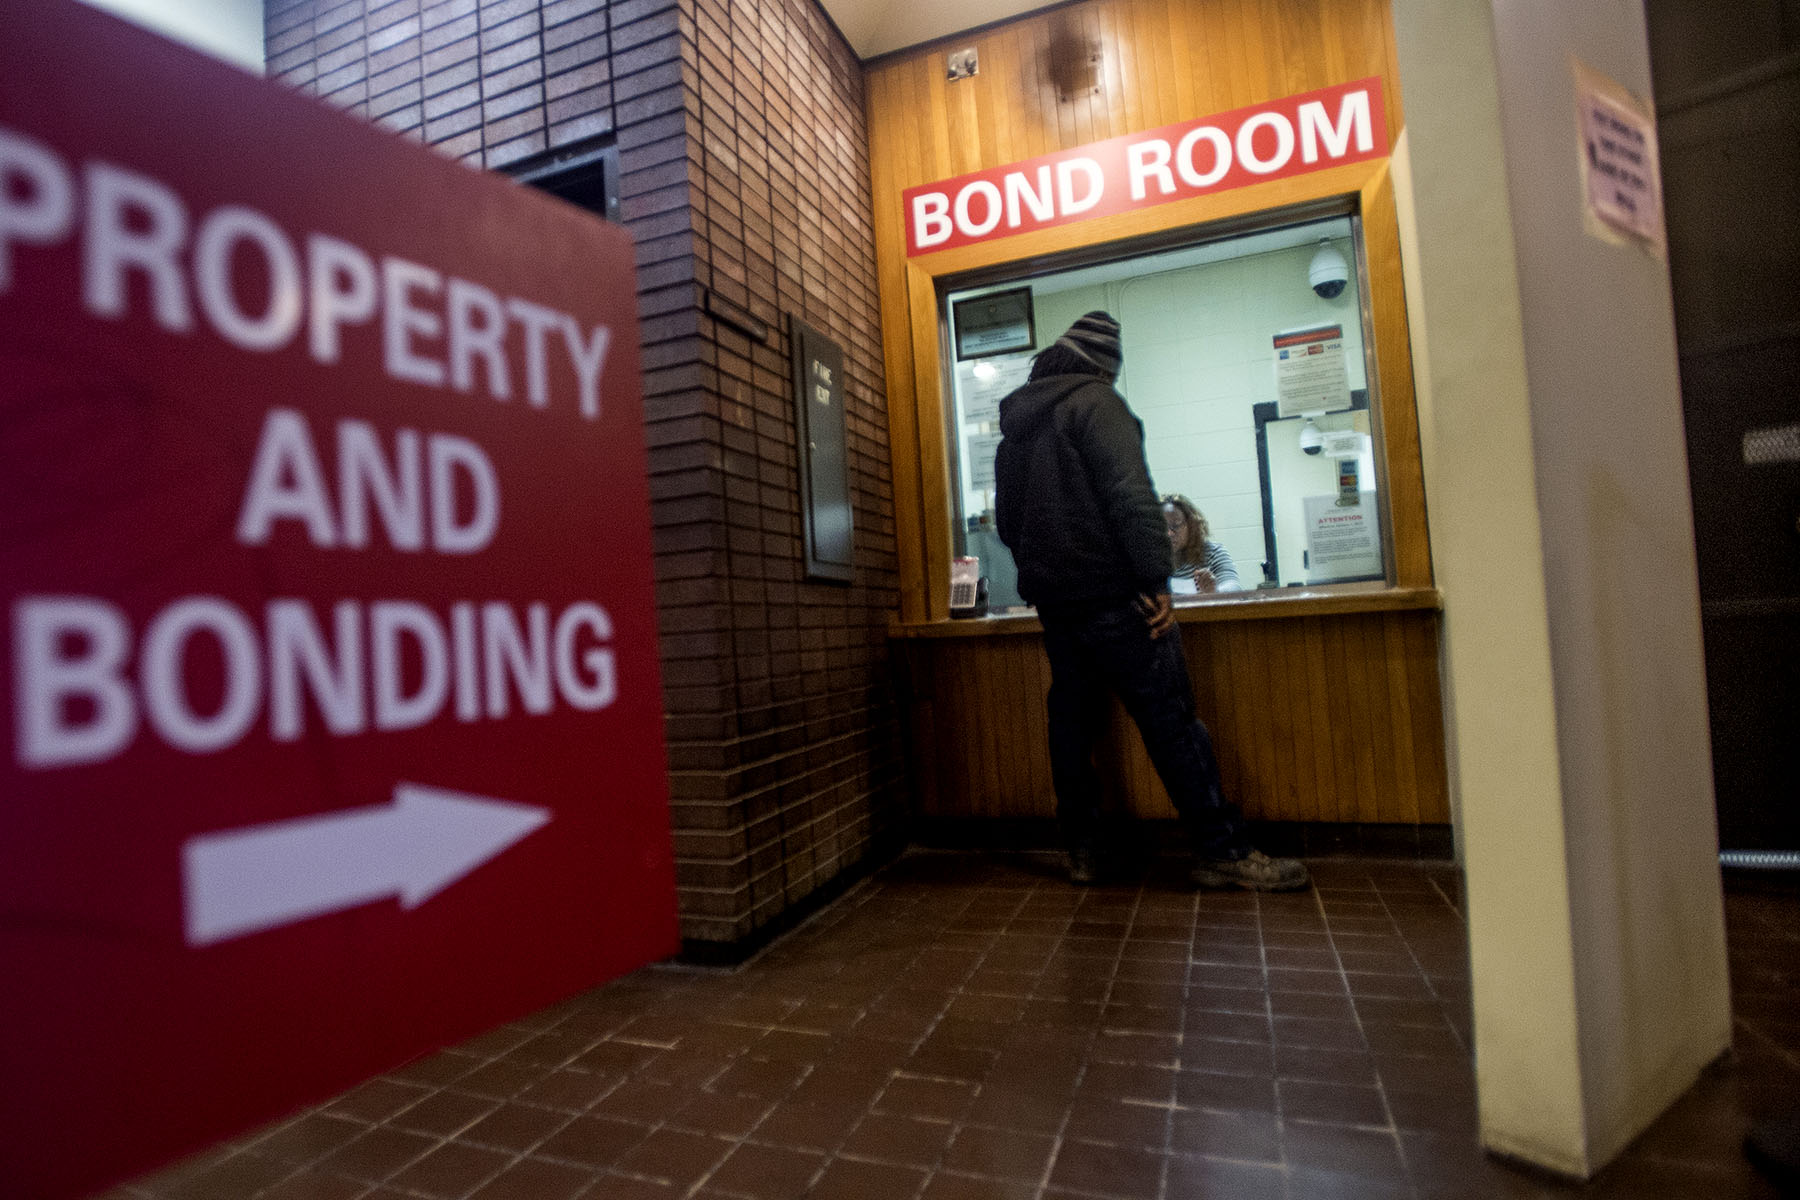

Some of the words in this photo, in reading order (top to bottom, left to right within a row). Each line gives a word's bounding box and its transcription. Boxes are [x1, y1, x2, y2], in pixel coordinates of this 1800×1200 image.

[912, 156, 1105, 249] BOND
[1126, 89, 1374, 200] ROOM
[0, 127, 610, 419] PROPERTY
[236, 408, 500, 555] AND
[1318, 515, 1362, 524] ATTENTION
[14, 594, 618, 769] BONDING
